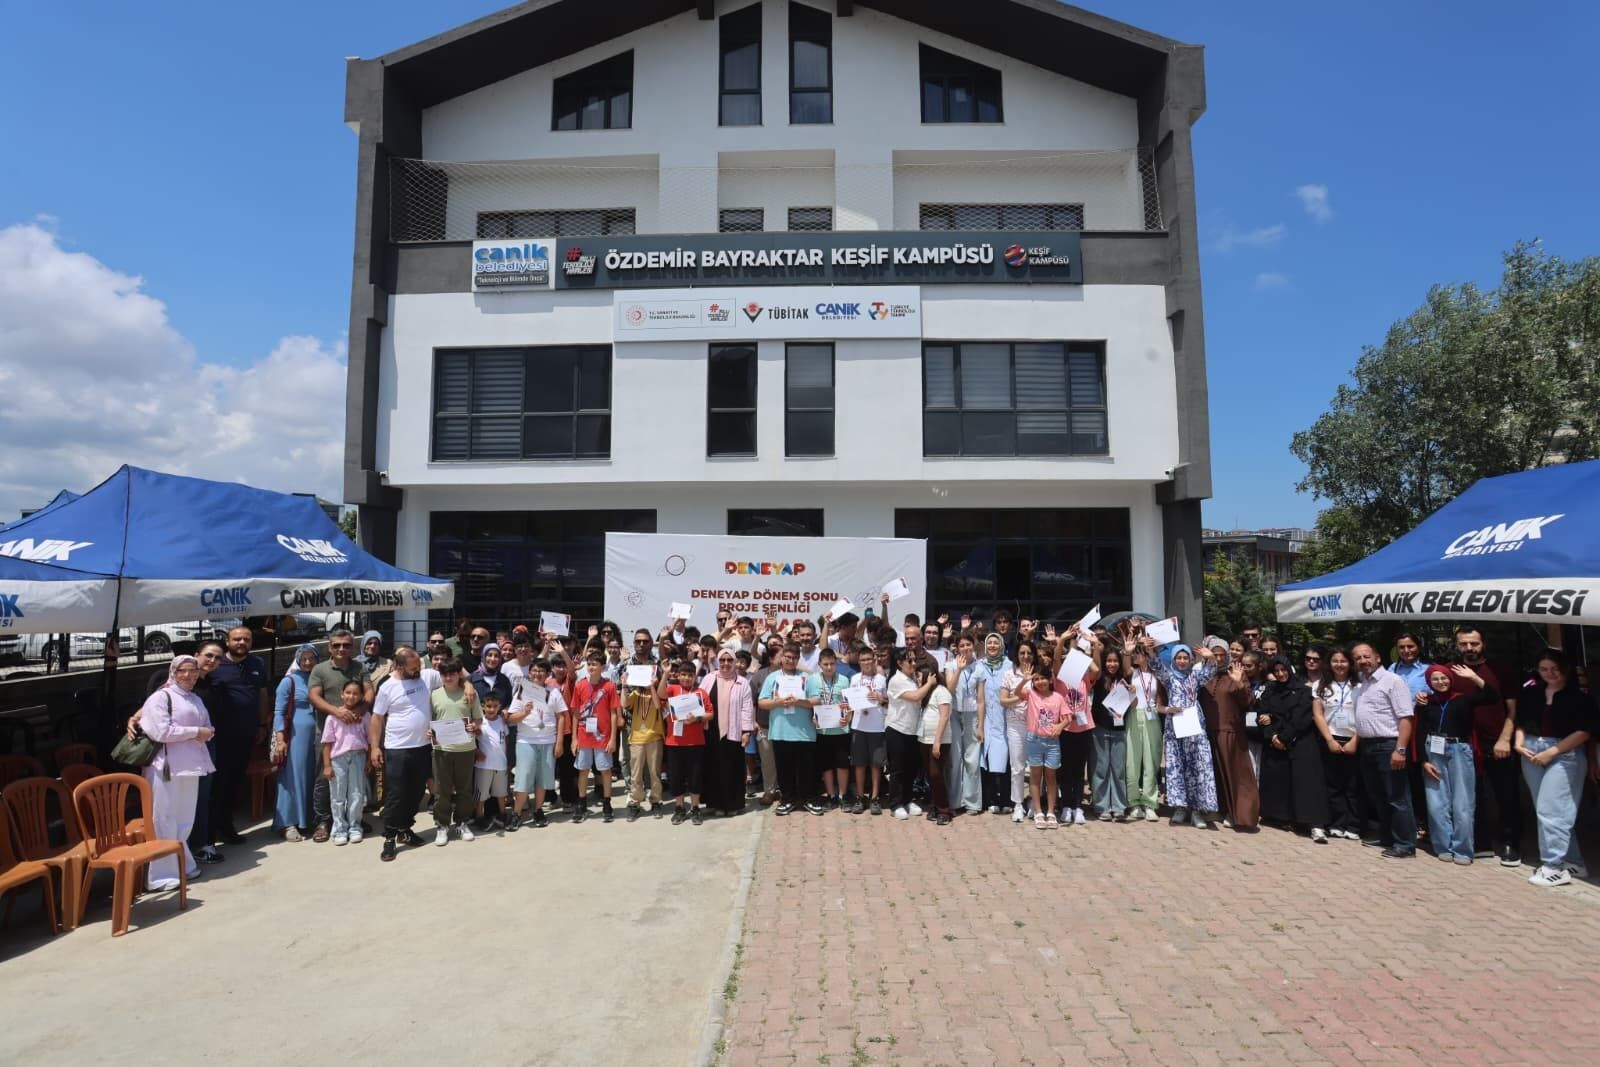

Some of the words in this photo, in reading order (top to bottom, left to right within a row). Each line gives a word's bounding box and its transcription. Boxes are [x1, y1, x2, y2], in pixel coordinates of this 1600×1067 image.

[475, 243, 549, 261] canik
[605, 248, 696, 270] ÖZDEMİR
[701, 249, 823, 268] BAYRAKTAR
[832, 244, 887, 268] KEŞİF
[894, 243, 993, 265] KAMPÜSÜ
[1028, 245, 1050, 257] KEŞİF
[475, 260, 547, 272] belediyesi
[1029, 255, 1069, 265] KAMPÜSÜ
[768, 307, 809, 319] TÜBİTAK
[815, 303, 861, 315] CANİK
[725, 561, 806, 575] DENEYAP
[200, 587, 252, 607] CANİK
[280, 588, 330, 609] CANİK
[334, 587, 403, 606] BELEDİYESİ
[691, 589, 750, 600] DENEYAP
[753, 588, 800, 601] DÖNEM
[803, 592, 838, 601] SONU
[718, 602, 759, 612] PROJE
[762, 602, 810, 613] ŞENLİĞİ
[1362, 591, 1420, 614] CANİK
[1420, 589, 1589, 616] BELEDİYESİ
